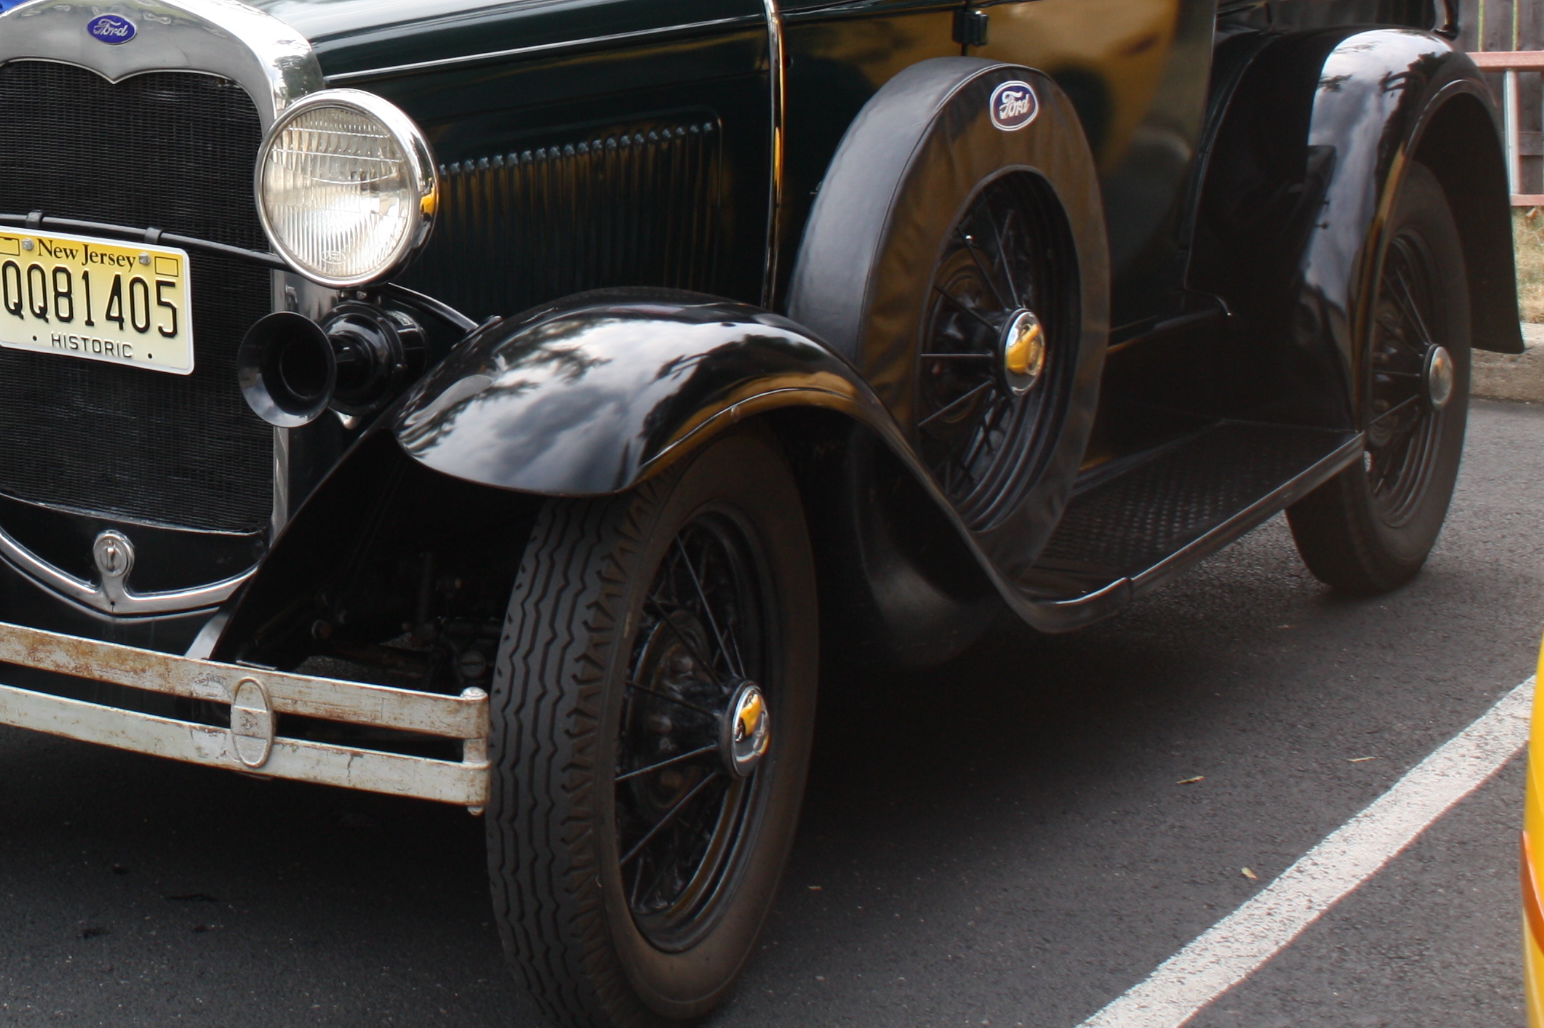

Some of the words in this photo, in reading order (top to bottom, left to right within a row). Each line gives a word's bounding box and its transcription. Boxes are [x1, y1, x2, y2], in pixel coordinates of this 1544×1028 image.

[93, 18, 128, 37] Ford
[999, 90, 1031, 120] Ford
[37, 237, 79, 262] New
[81, 243, 137, 273] Jersey
[1, 260, 179, 339] QQ81405
[50, 332, 134, 359] HISTORIC
